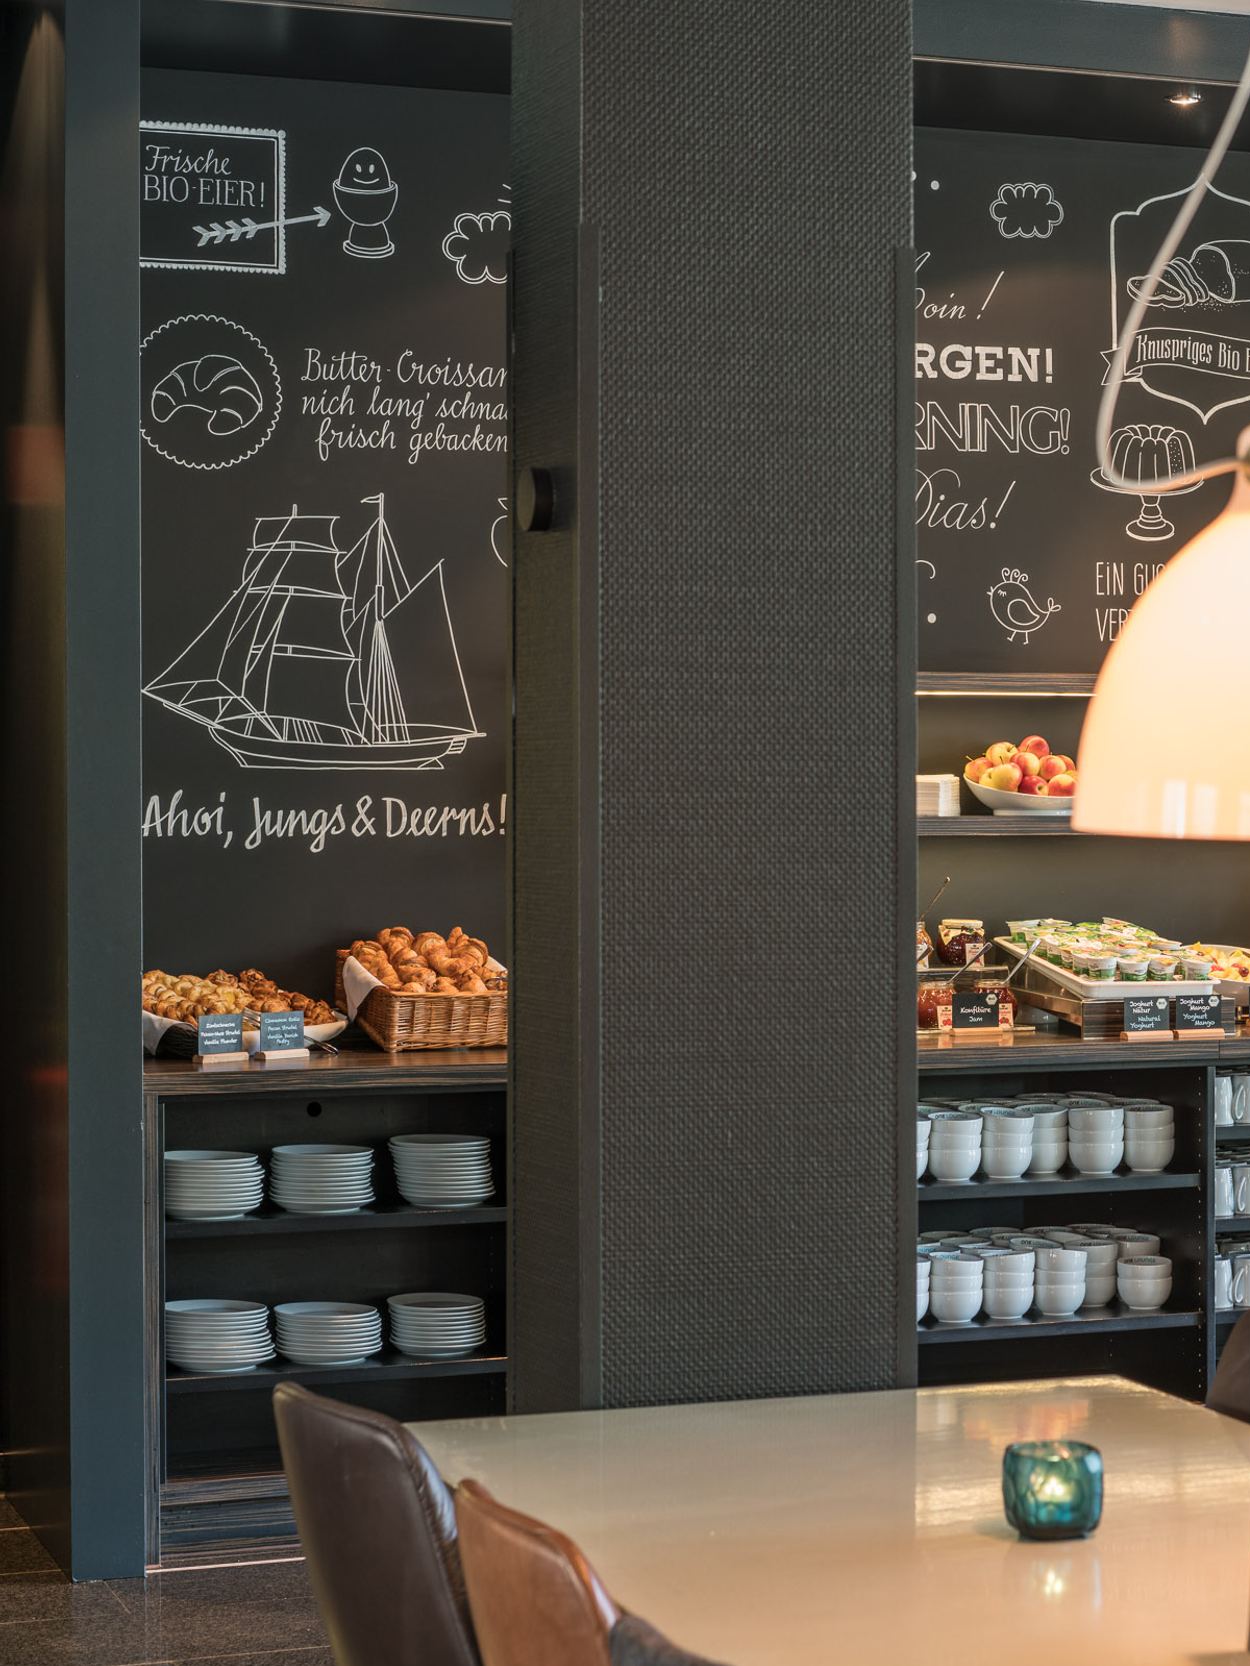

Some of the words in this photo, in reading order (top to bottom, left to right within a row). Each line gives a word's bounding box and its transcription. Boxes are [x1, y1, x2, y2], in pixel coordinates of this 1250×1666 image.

[145, 144, 232, 175] Frische
[143, 174, 265, 208] BIO-EIER!
[1135, 334, 1213, 365] Knuspriges
[1218, 341, 1240, 371] Bio
[302, 384, 355, 416] nich
[434, 391, 508, 421] schna
[315, 417, 396, 462] frisch
[408, 422, 508, 465] gebacken
[1095, 608, 1134, 642] VER
[141, 789, 233, 849] Ahoi,
[245, 796, 348, 853] Jungs
[351, 794, 376, 837] &
[381, 793, 508, 838] Deerns!
[960, 1005, 992, 1015] Konfitüre
[1194, 1020, 1216, 1028] Mango
